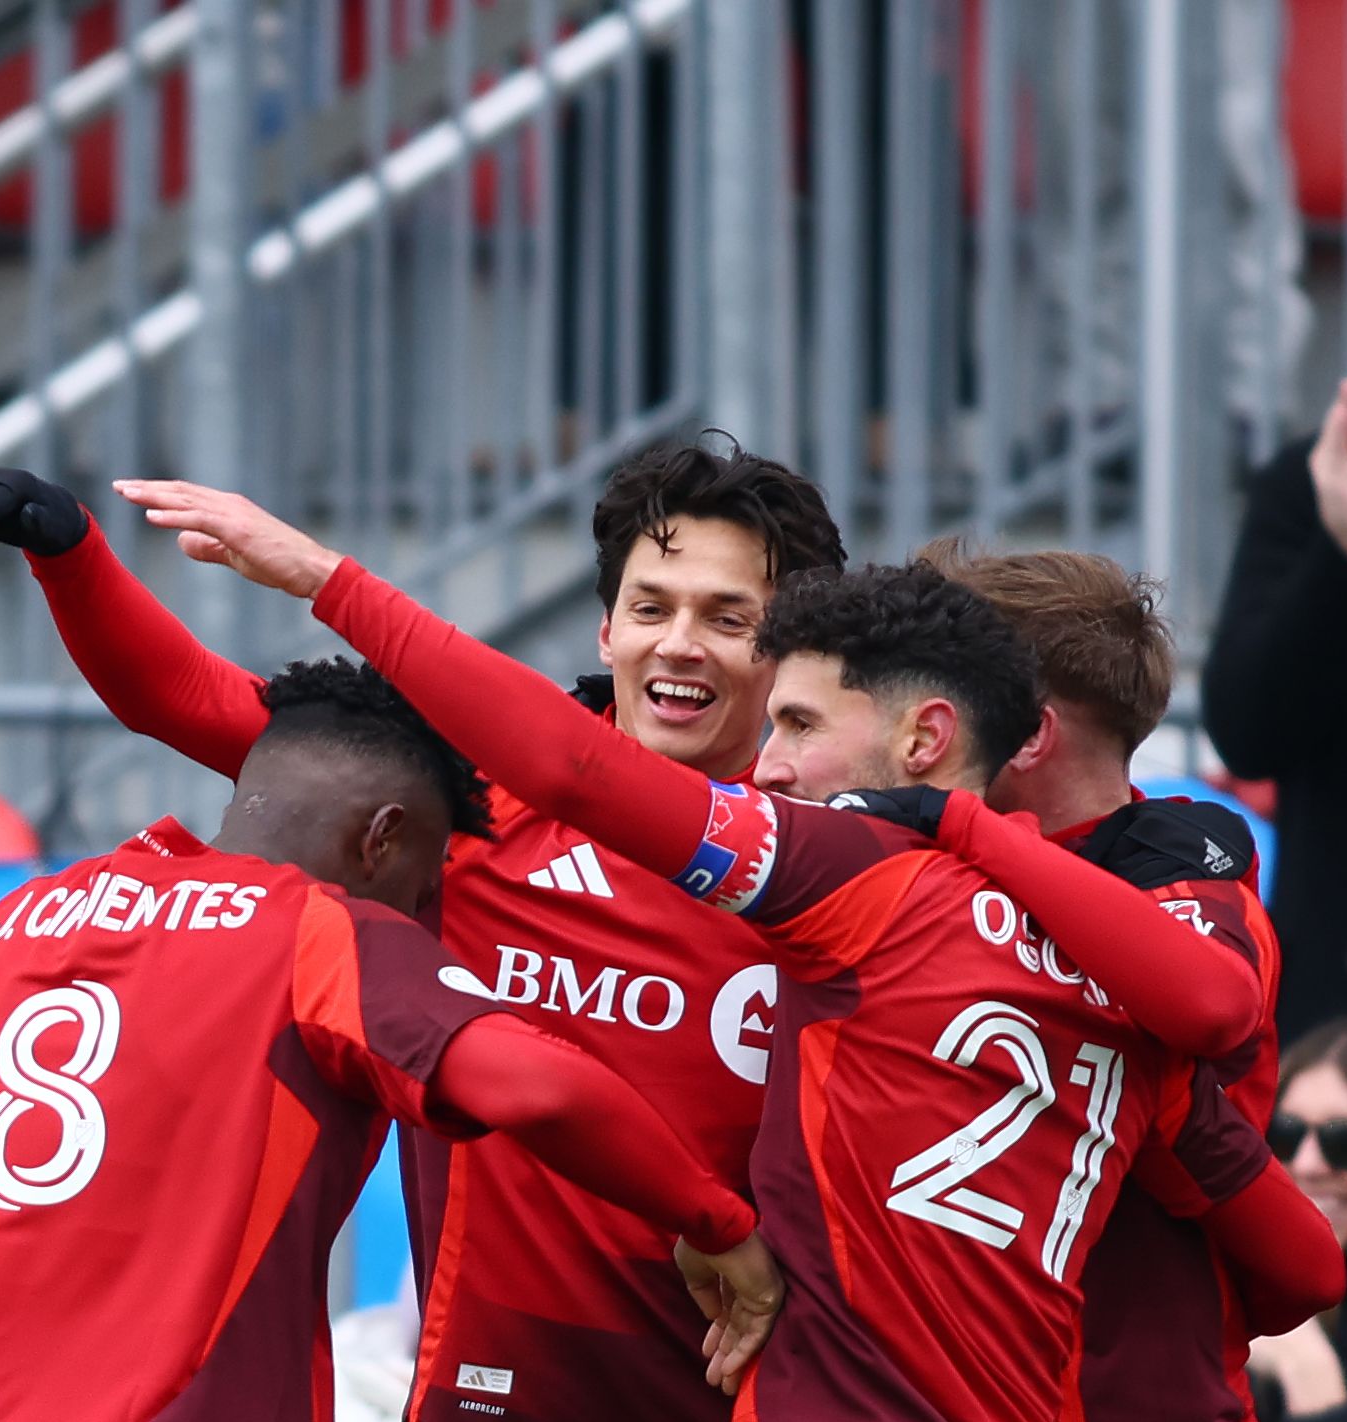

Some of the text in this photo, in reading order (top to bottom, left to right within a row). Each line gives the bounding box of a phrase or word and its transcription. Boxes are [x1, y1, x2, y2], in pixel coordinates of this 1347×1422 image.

[496, 945, 686, 1032] BMO
[885, 1001, 1125, 1284] 21
[459, 1400, 506, 1416] AEROREADY
